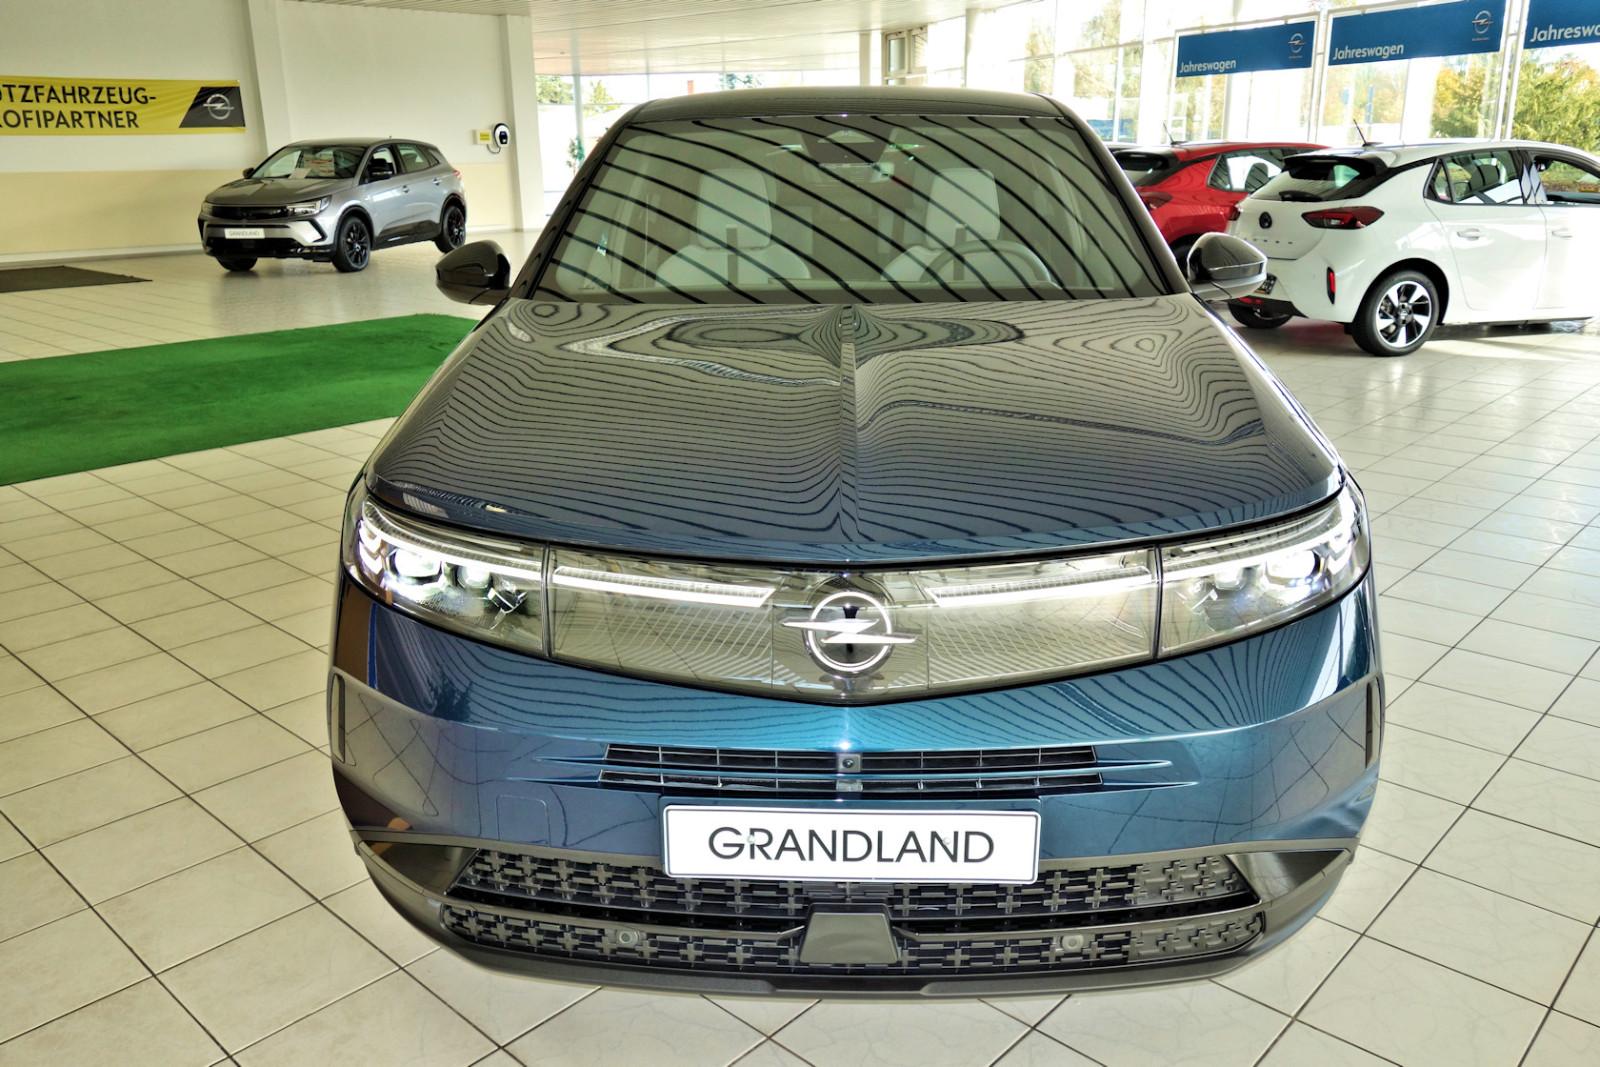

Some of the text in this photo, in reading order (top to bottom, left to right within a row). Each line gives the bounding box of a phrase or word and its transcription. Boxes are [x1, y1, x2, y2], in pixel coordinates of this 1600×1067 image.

[1333, 44, 1405, 60] Jahreswagen
[1179, 59, 1237, 73] Jahreswagen
[0, 83, 157, 105] TZFAHRZEUG-
[0, 109, 140, 129] OFIPARTNER
[708, 826, 994, 864] GRANDLAND
